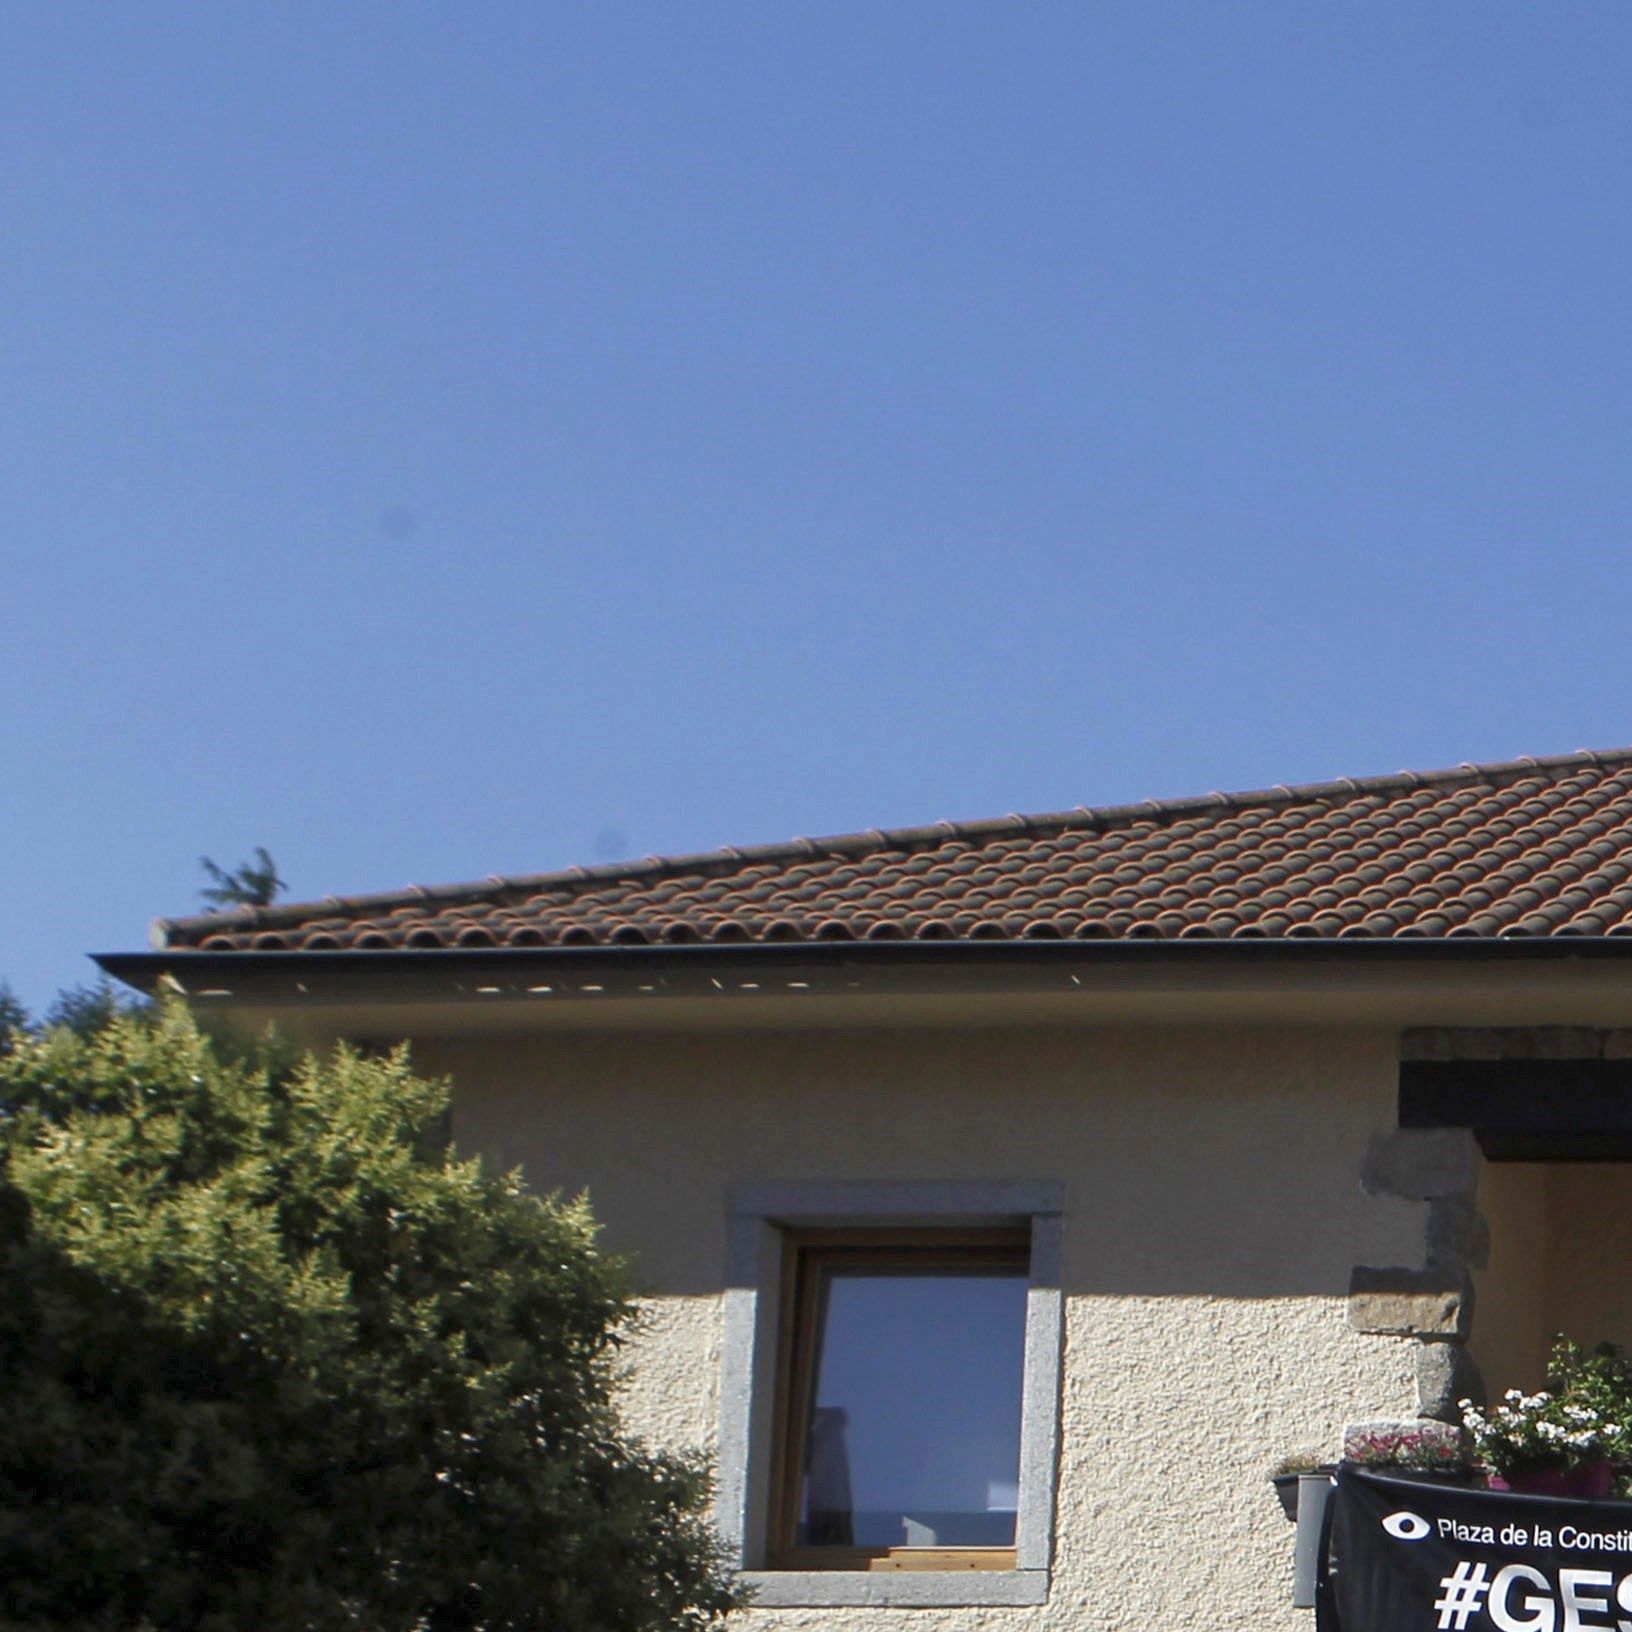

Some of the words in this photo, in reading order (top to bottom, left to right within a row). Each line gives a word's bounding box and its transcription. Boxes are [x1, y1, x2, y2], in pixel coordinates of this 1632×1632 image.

[1437, 1518, 1495, 1544] Plaza
[1500, 1523, 1528, 1546] de
[1534, 1524, 1552, 1547] la
